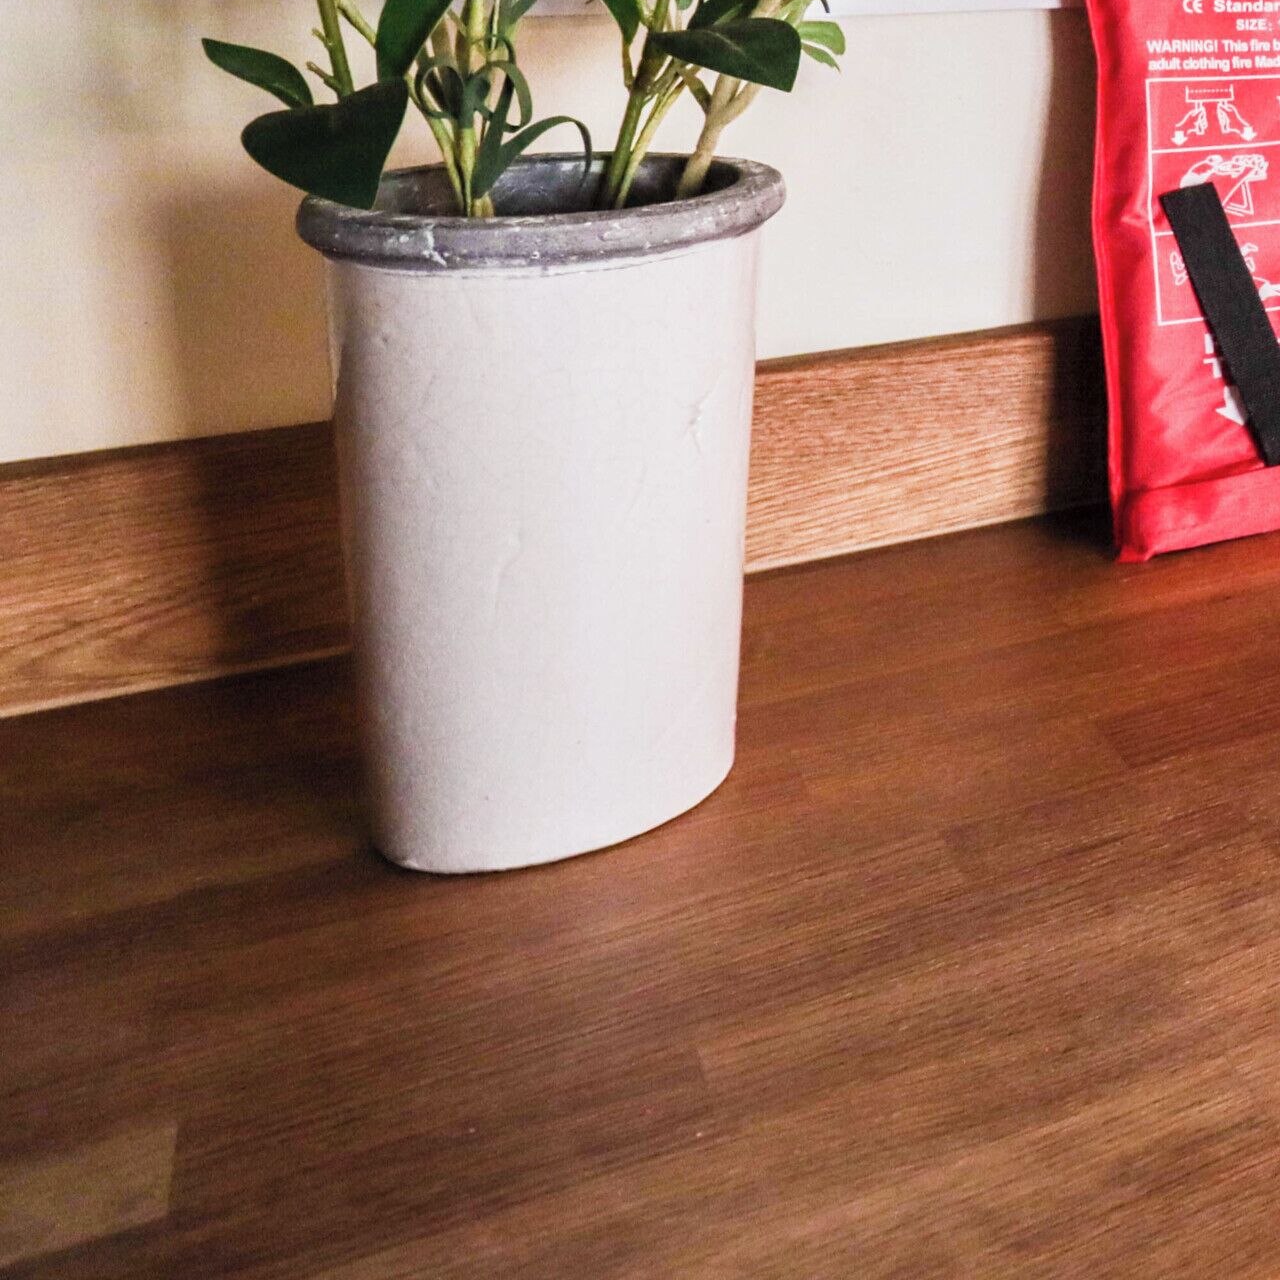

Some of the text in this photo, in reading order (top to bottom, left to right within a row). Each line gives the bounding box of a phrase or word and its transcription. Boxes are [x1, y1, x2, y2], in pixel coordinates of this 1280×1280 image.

[1235, 18, 1273, 31] SIZE:
[1146, 39, 1218, 53] WARNING!
[1222, 39, 1248, 52] This
[1250, 38, 1271, 52] fire
[1148, 58, 1180, 70] adult
[1182, 57, 1230, 72] clothing
[1232, 56, 1252, 69] fire
